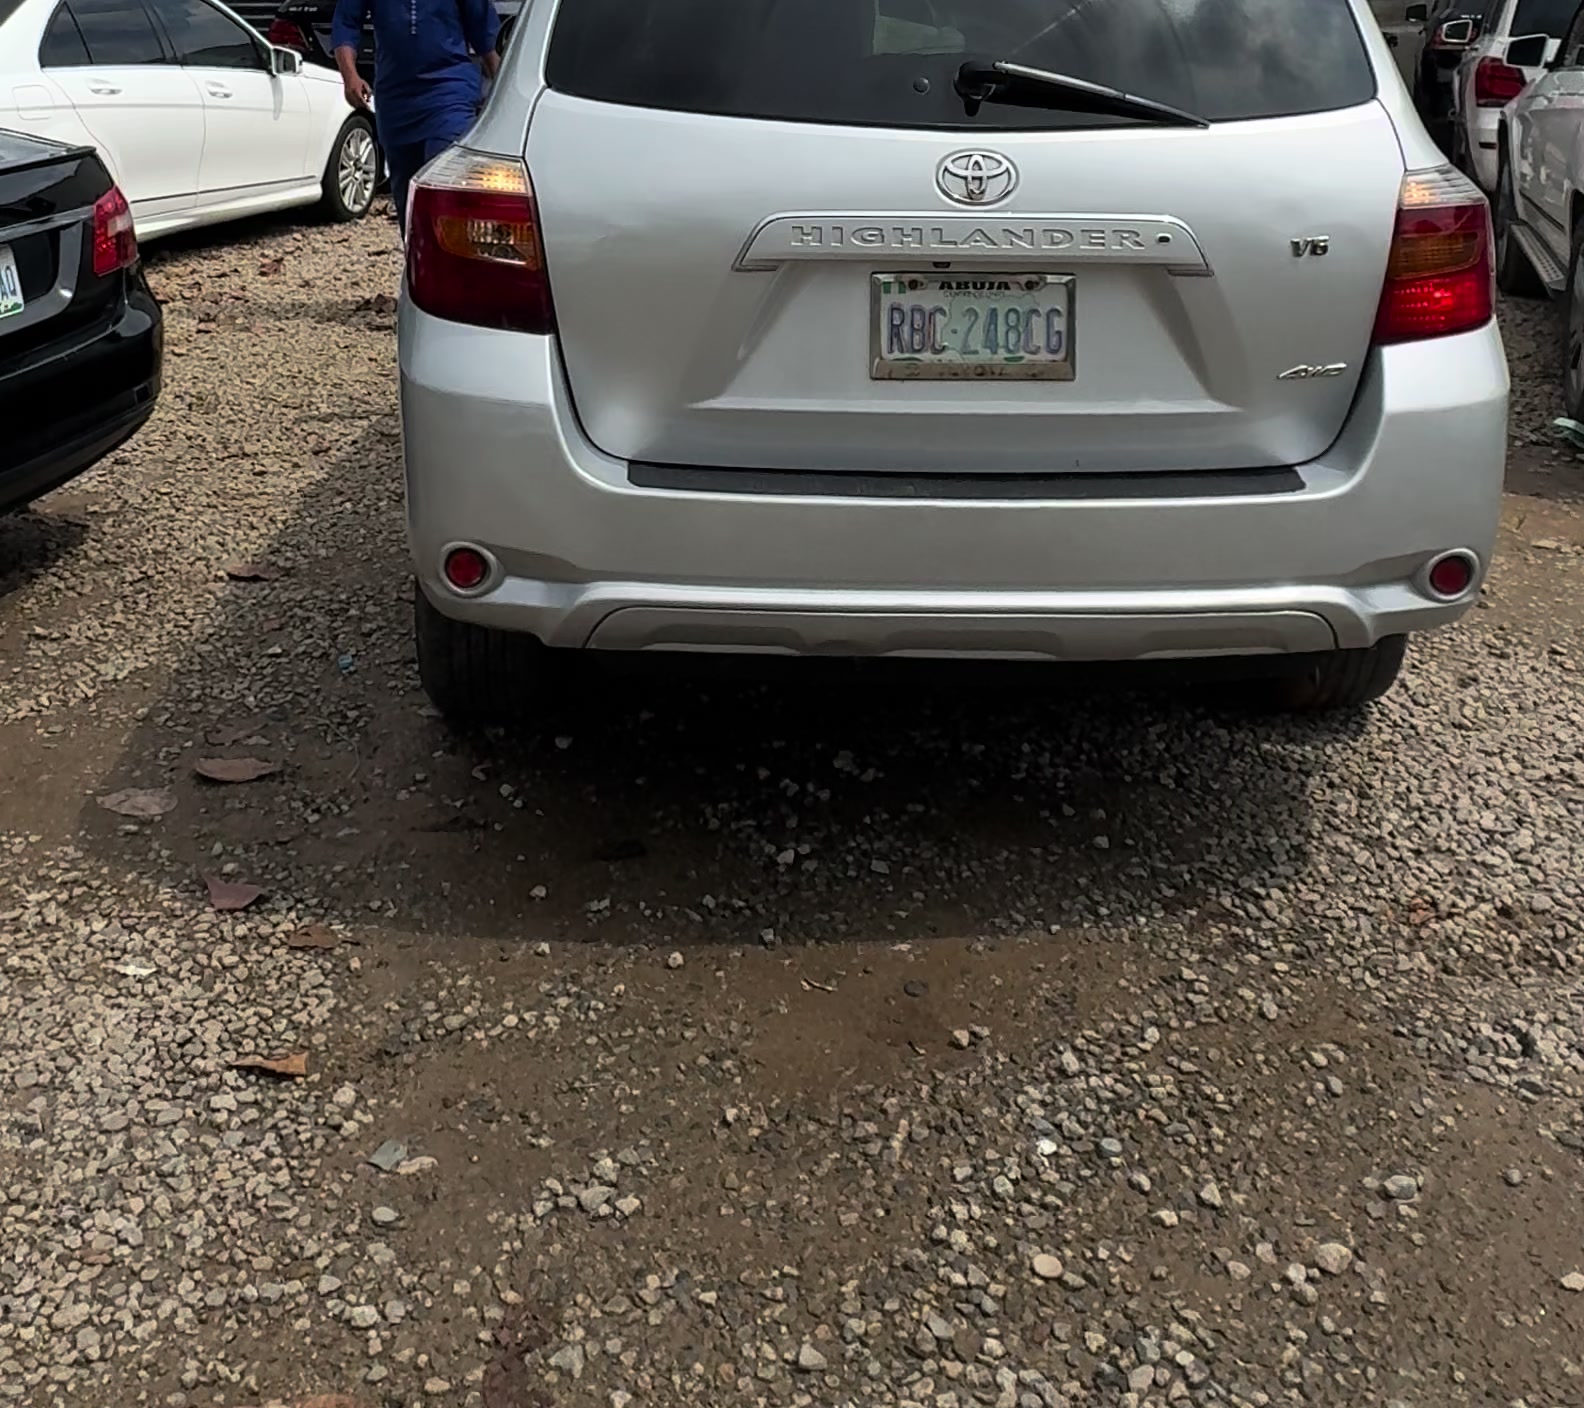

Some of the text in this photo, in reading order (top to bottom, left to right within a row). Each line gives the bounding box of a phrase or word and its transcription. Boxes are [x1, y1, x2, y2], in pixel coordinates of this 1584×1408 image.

[791, 226, 1145, 250] HIGHLANDER
[1290, 235, 1330, 258] V6
[939, 280, 1011, 291] ABUJA
